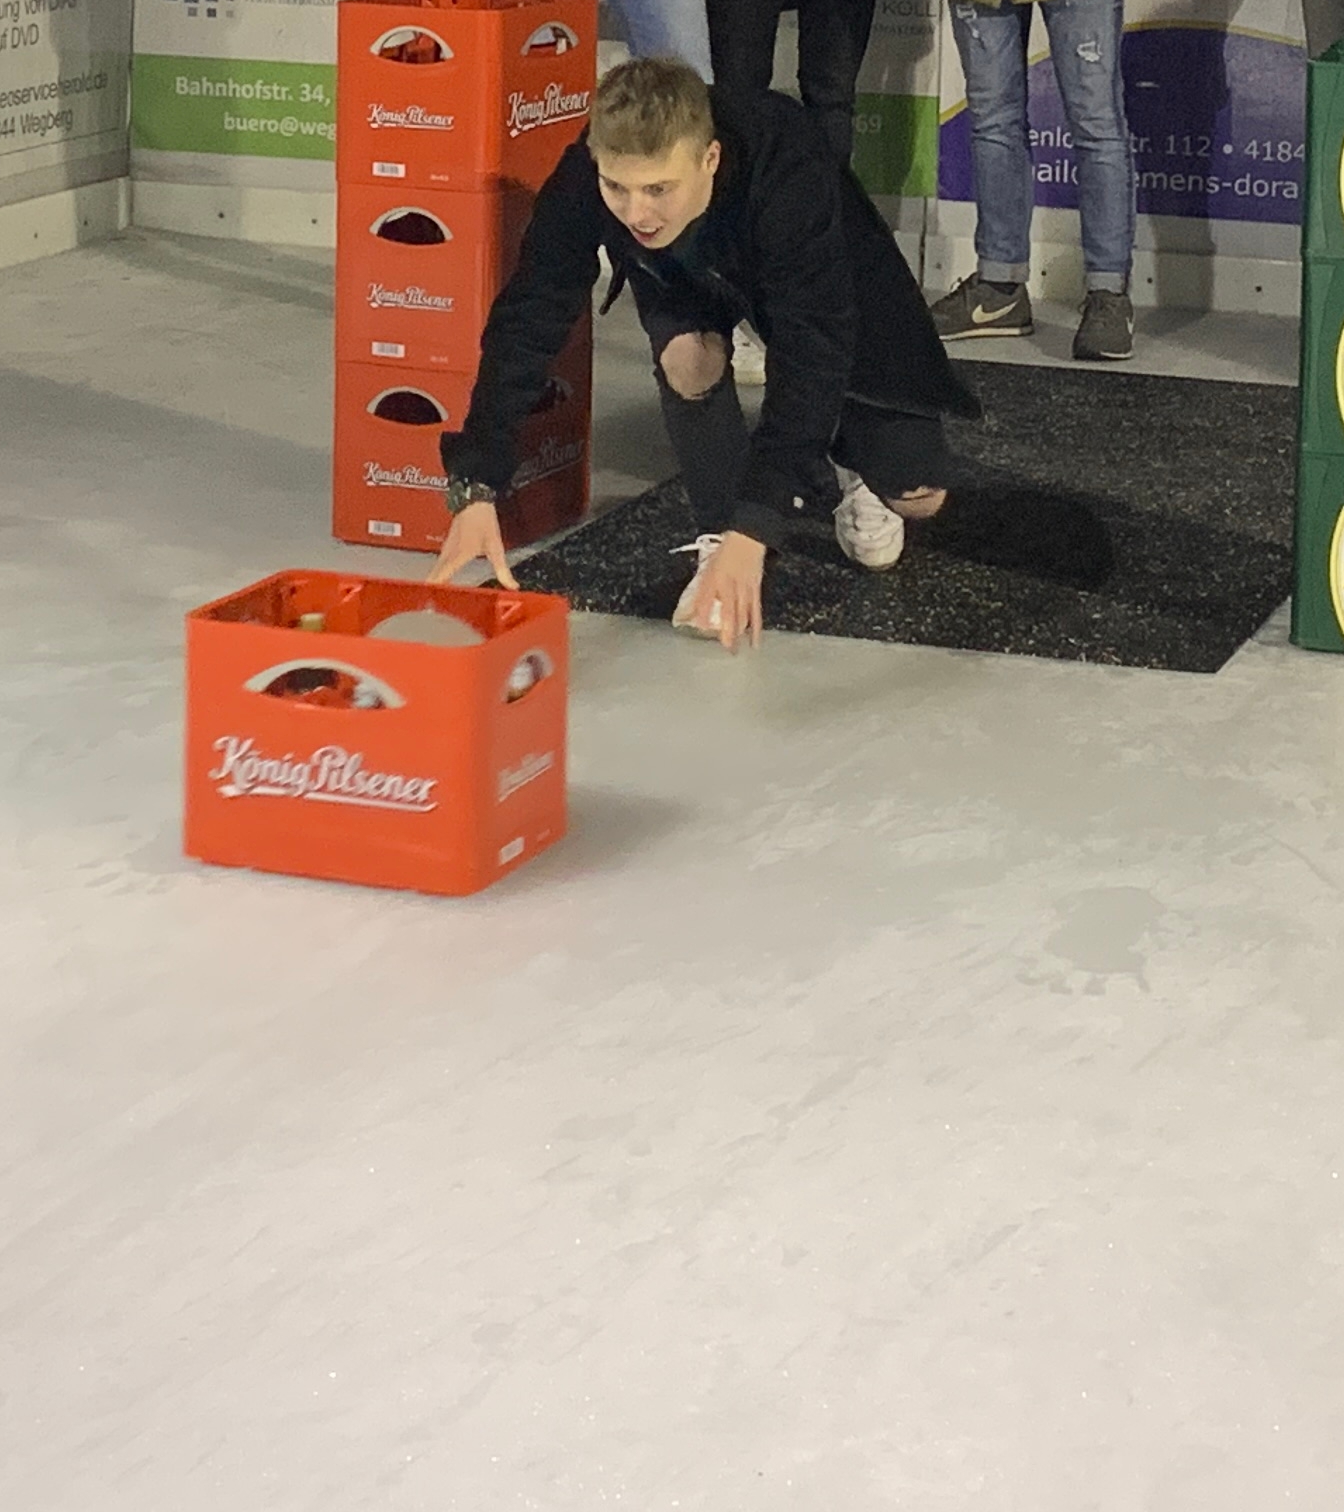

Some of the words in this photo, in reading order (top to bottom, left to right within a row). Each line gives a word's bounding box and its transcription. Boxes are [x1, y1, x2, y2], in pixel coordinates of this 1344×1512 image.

[882, 0, 937, 18] KOLL
[10, 23, 40, 48] DVD
[174, 76, 294, 103] Bahnhofstr.
[299, 82, 331, 107] 34,
[20, 108, 74, 138] Wegberg
[1164, 134, 1211, 157] 112
[1133, 169, 1300, 200] emens-dora
[208, 735, 309, 793] König
[305, 744, 439, 804] Pilsener
